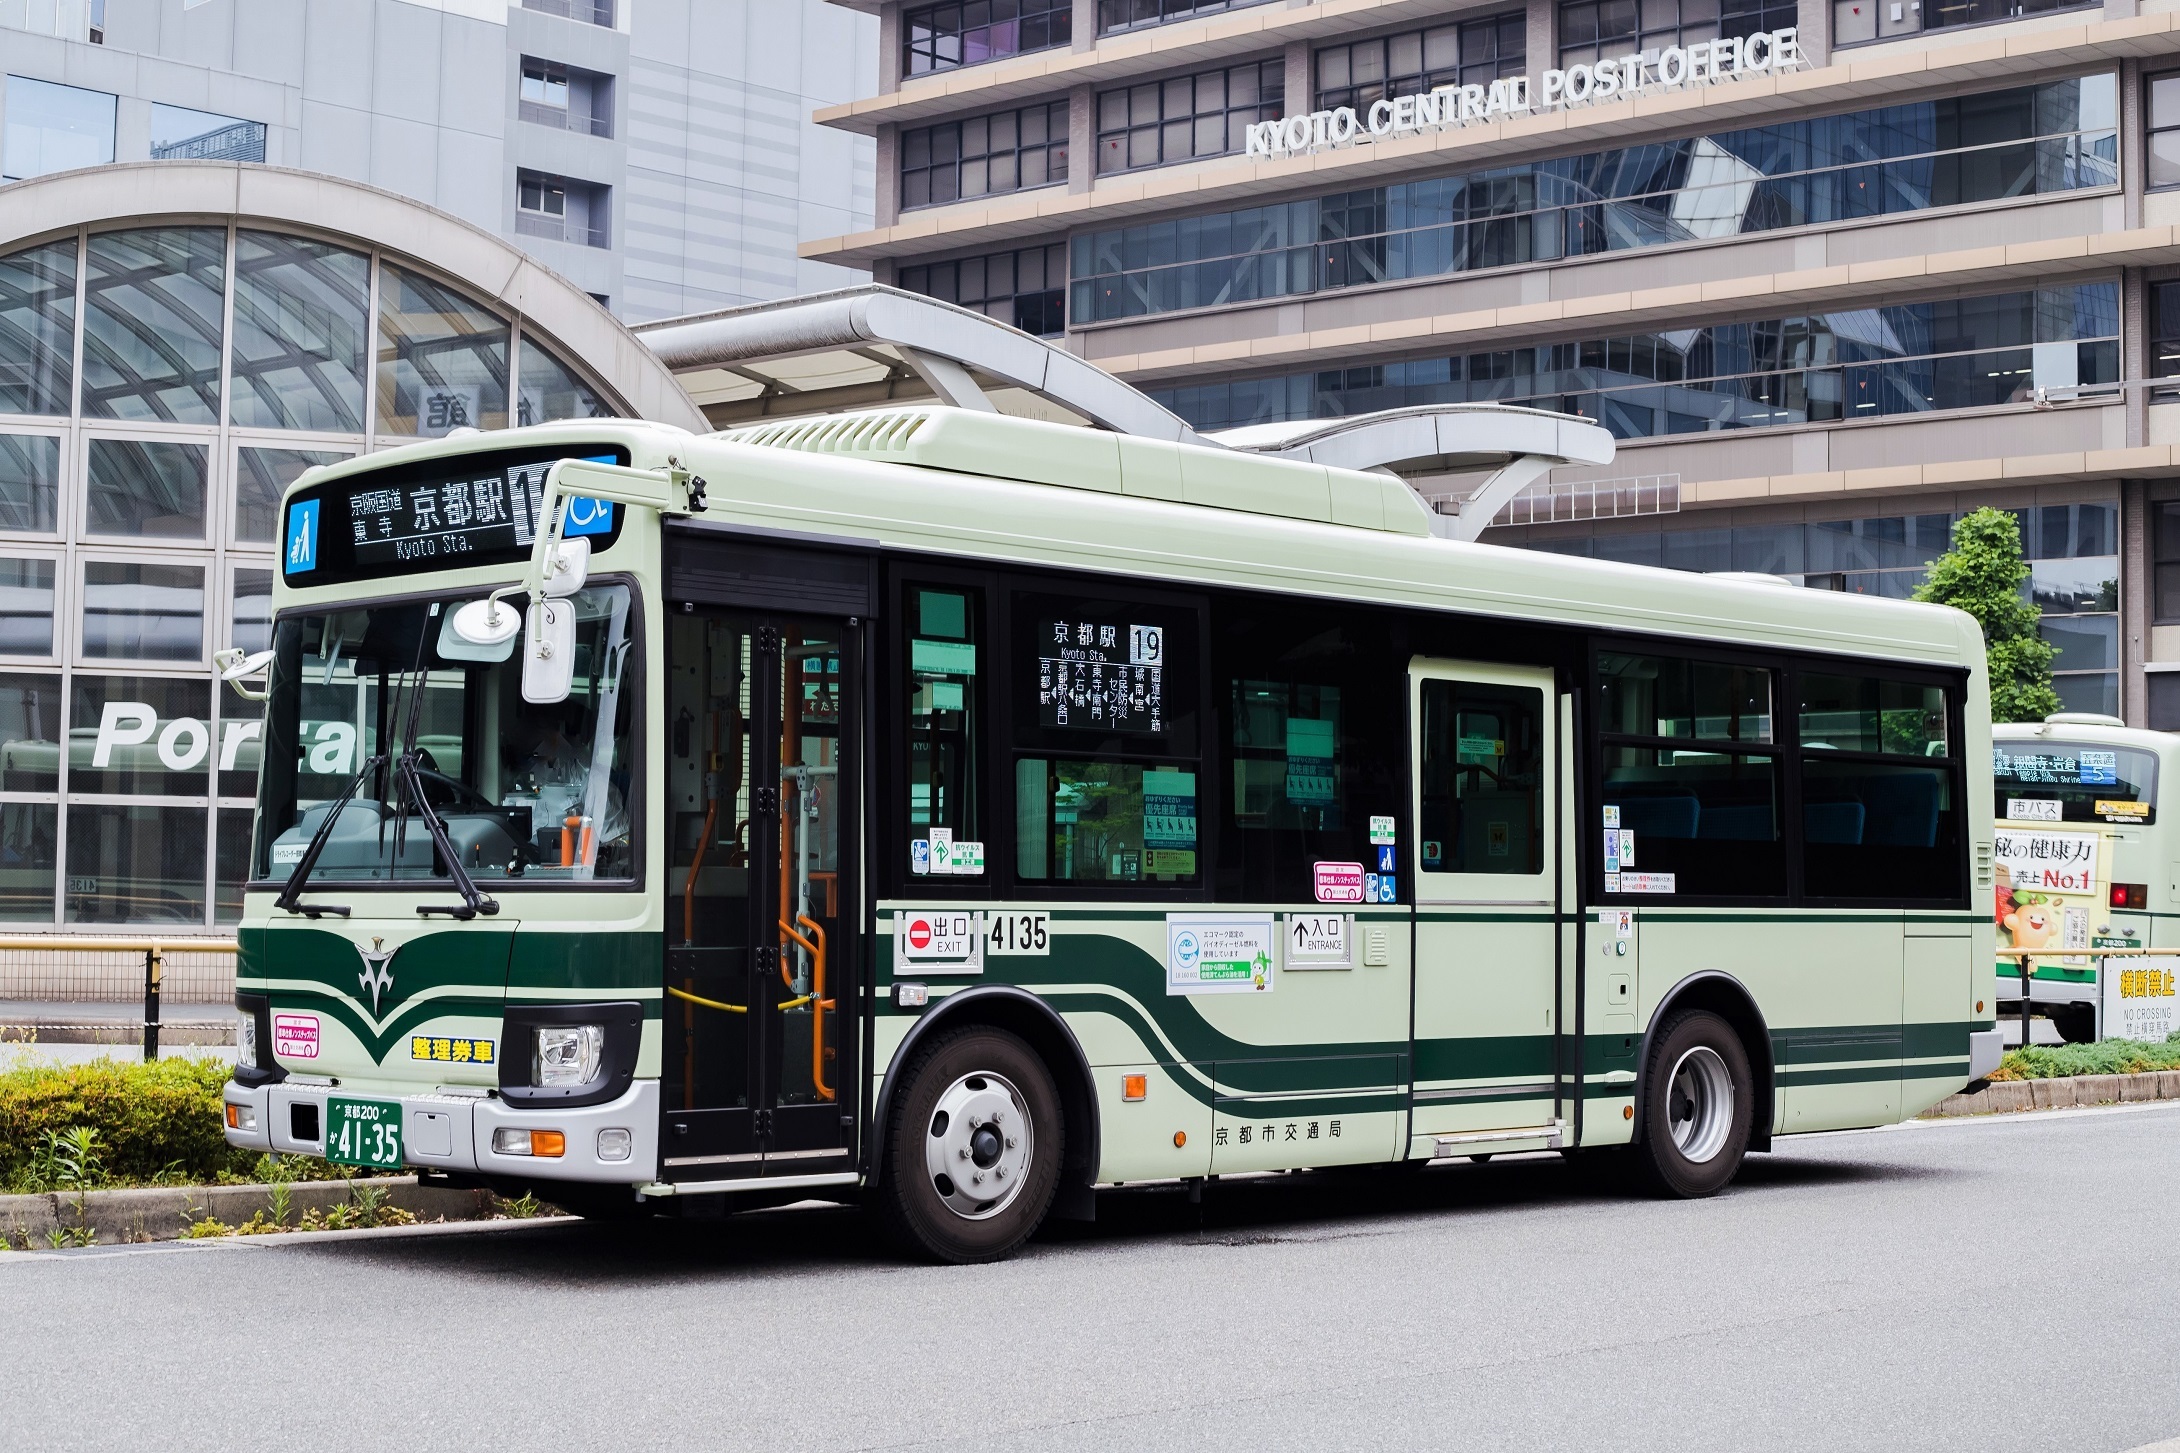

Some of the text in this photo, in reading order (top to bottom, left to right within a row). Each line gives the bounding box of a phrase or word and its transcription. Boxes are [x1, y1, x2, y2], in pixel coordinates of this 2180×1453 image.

[1245, 26, 1799, 158] KYOTO CENTRAL POST OFFICE
[349, 488, 402, 516] 京阪国道
[409, 476, 508, 531] 京都駅
[352, 515, 393, 541] 東寺
[396, 533, 473, 560] Kyoto Sta.
[1053, 620, 1116, 648] 京都駅
[1134, 629, 1160, 661] 19
[1061, 647, 1107, 662] Kyoto Sta.
[1040, 660, 1051, 705] 京都駅
[1057, 661, 1068, 725] 京都駅八条口
[1075, 662, 1085, 708] 大石橋
[1091, 664, 1102, 720] 東寺南門
[1134, 667, 1145, 712] 城南宮
[1150, 668, 1161, 732] 国道大手筋
[92, 701, 357, 774] Pora
[2092, 767, 2105, 781] 5
[1145, 803, 1177, 816] 優先座席
[2012, 800, 2057, 815] 市バス
[1994, 836, 2092, 868] 秘の健康力
[2015, 869, 2041, 884] 売上
[2043, 868, 2090, 890] No.1
[933, 917, 967, 937] 出口
[990, 916, 1047, 950] 4135
[1203, 930, 1244, 939] エコマーク認定の
[1312, 918, 1339, 937] 入口
[937, 941, 962, 952] EXIT
[1203, 940, 1259, 948] バイオディーゼル燃料を
[1203, 950, 1239, 958] 使用しています
[1307, 940, 1343, 951] ENTRANCE
[2120, 969, 2176, 999] 横断禁止
[2123, 1007, 2172, 1020] NO CROSSING
[412, 1036, 494, 1063] 整理券車
[343, 1103, 380, 1121] 京都200
[329, 1131, 338, 1145] か
[1215, 1119, 1343, 1147] 京都市交通局
